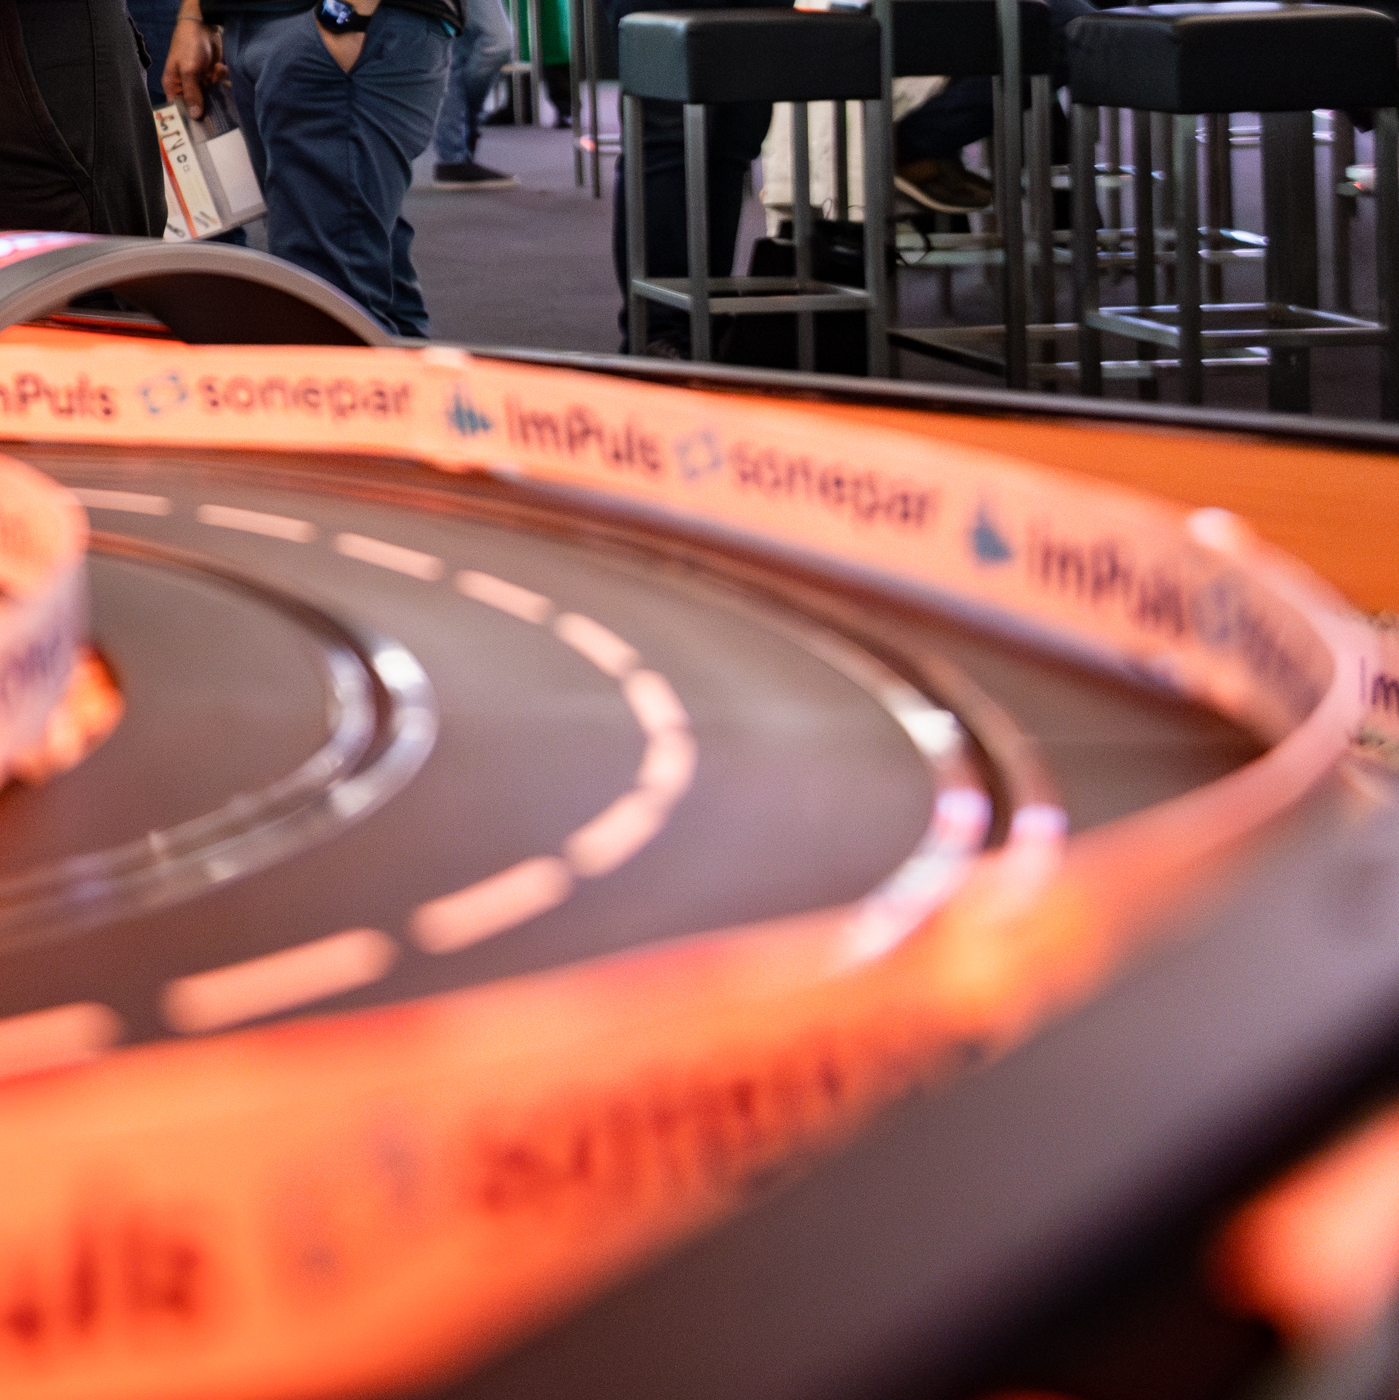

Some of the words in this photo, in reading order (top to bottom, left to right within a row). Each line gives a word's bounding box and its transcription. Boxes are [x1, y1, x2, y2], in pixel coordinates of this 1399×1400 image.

[201, 372, 415, 424] sonepar
[503, 396, 666, 480] ImPuls
[727, 434, 941, 531] sonepar
